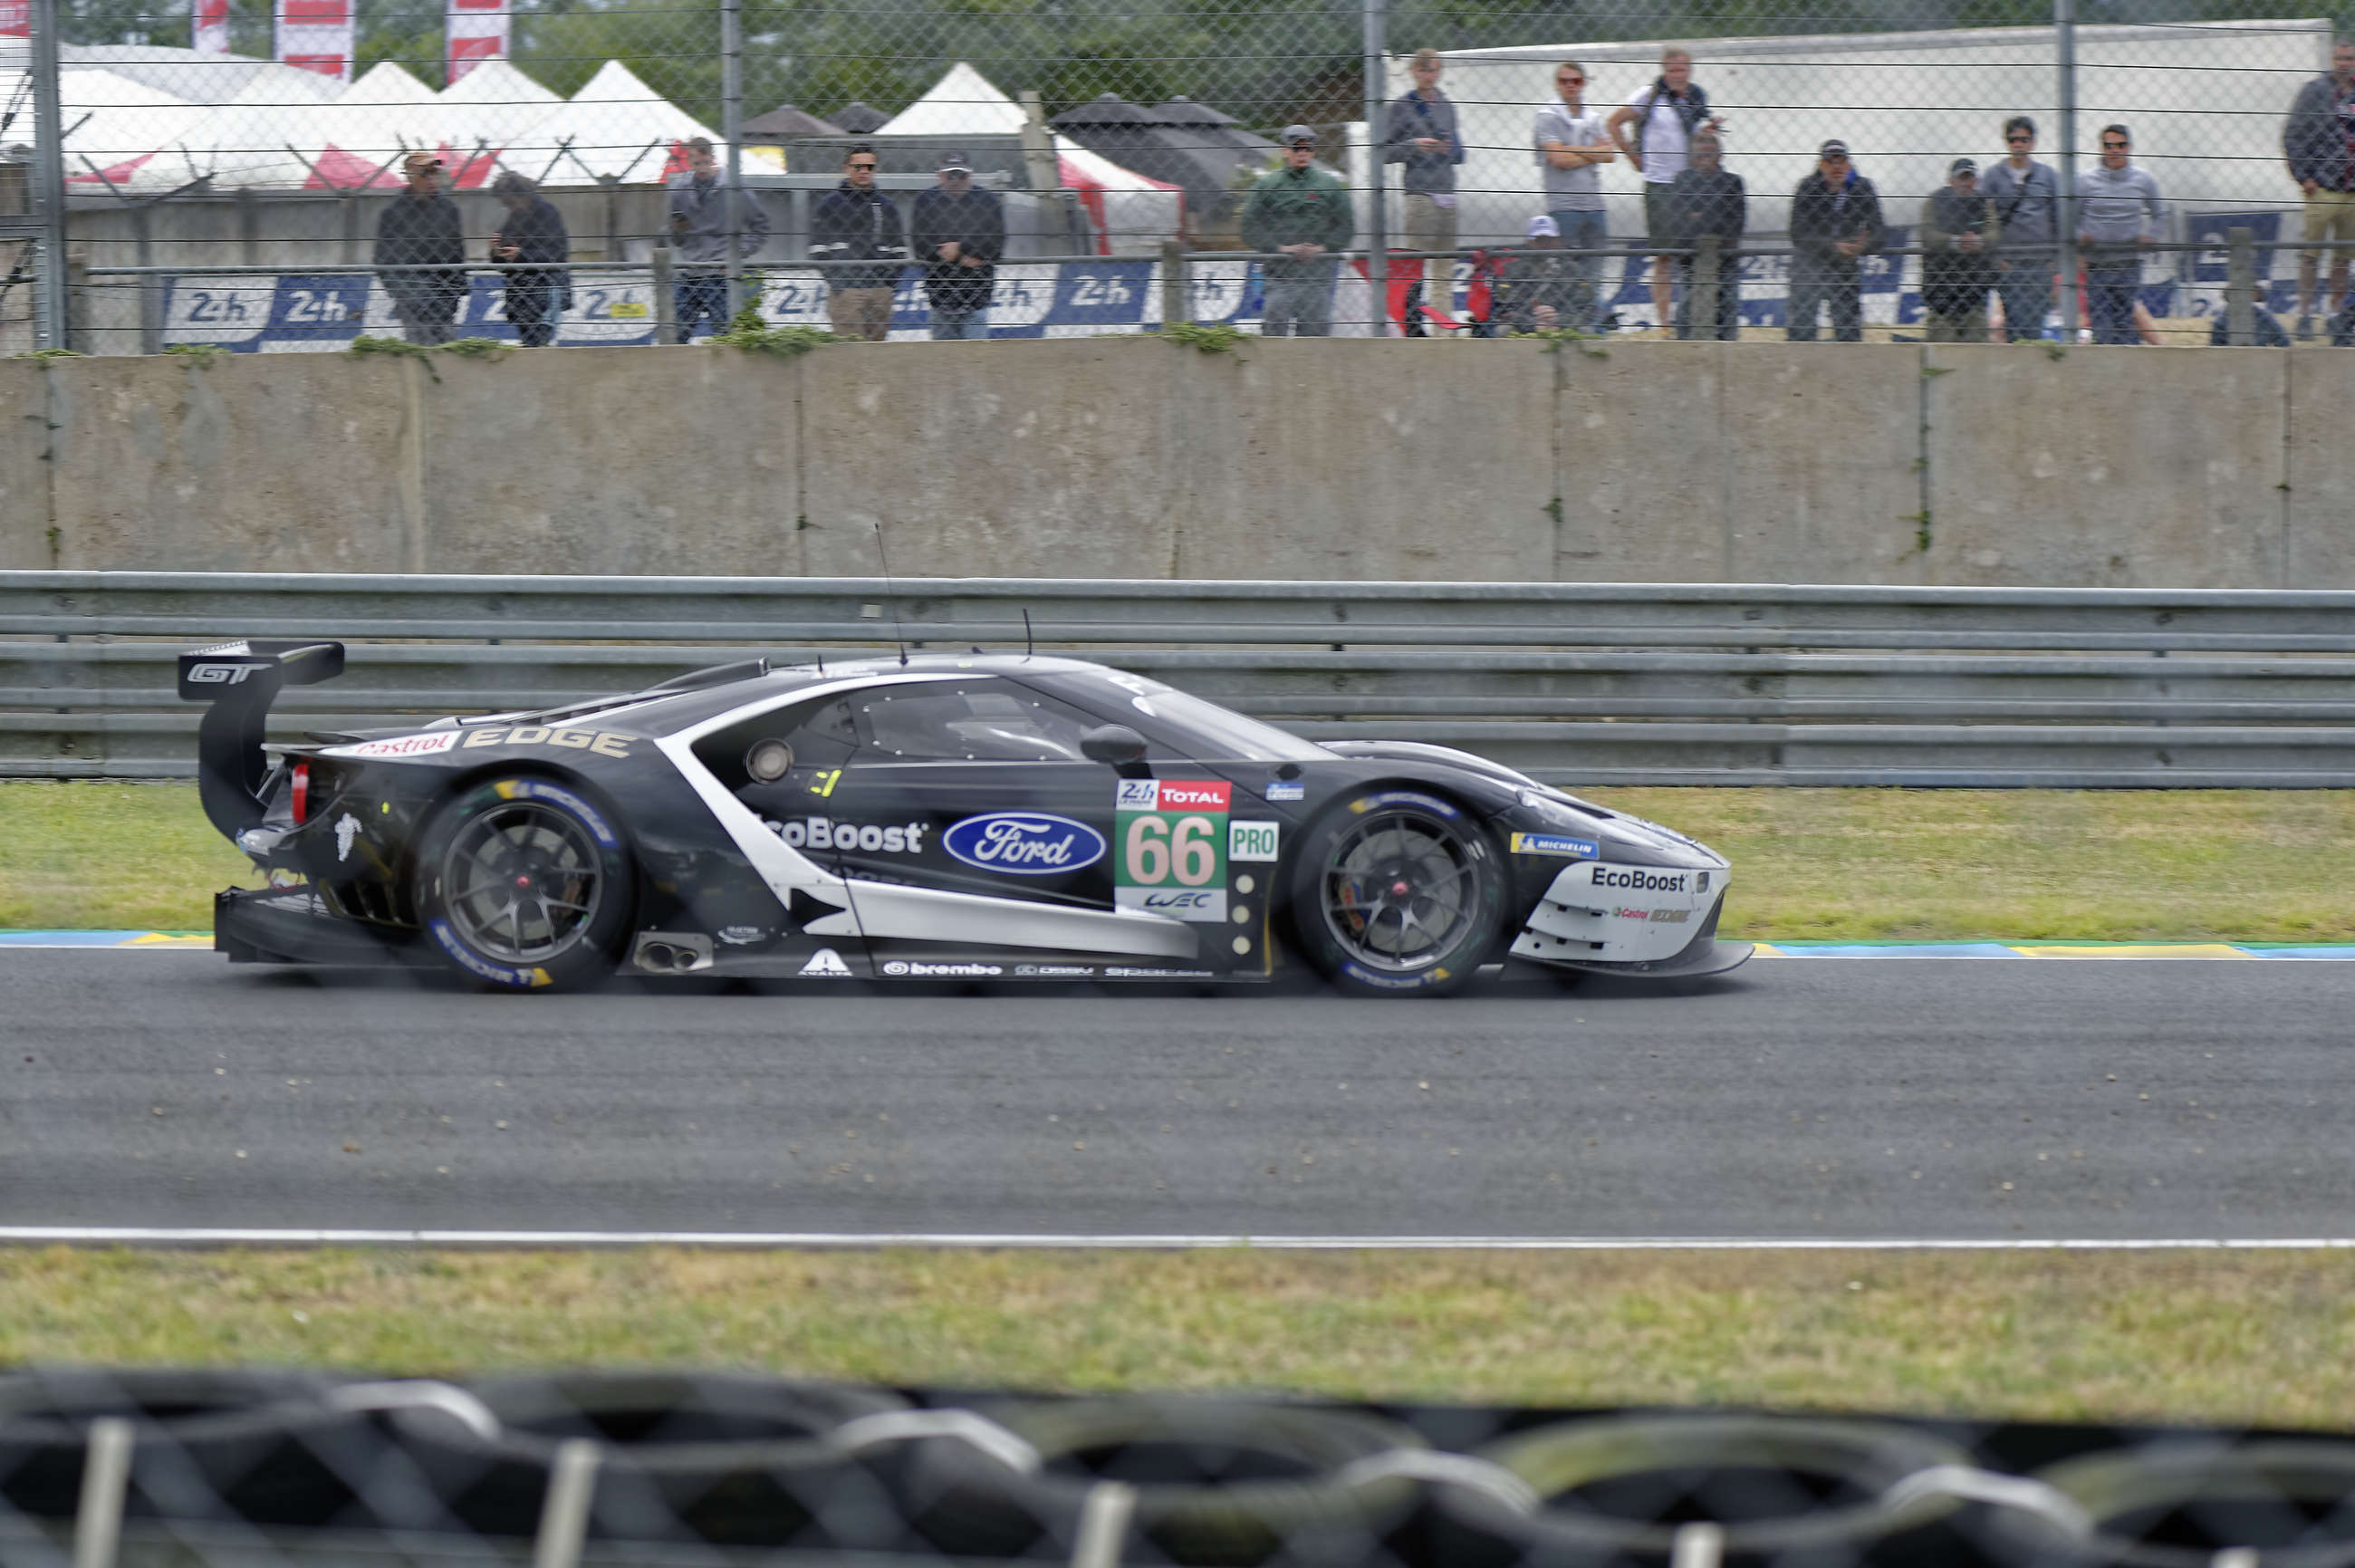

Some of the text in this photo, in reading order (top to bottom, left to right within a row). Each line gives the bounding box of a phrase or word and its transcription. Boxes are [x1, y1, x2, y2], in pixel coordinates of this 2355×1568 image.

[1069, 274, 1131, 305] 24h
[188, 292, 246, 322] 24h
[284, 290, 349, 322] 24h
[187, 663, 274, 685] GT
[358, 727, 638, 759] Castrol EDGE
[1121, 783, 1155, 800] 24h
[1161, 788, 1225, 804] TOTAL
[974, 820, 1075, 865] Ford
[1126, 815, 1216, 887] 66
[1233, 829, 1274, 855] PRO
[1536, 840, 1592, 854] MICHELIN
[1591, 867, 1687, 892] EcoBoost
[1144, 892, 1212, 908] WEC
[909, 963, 1003, 976] brembo
